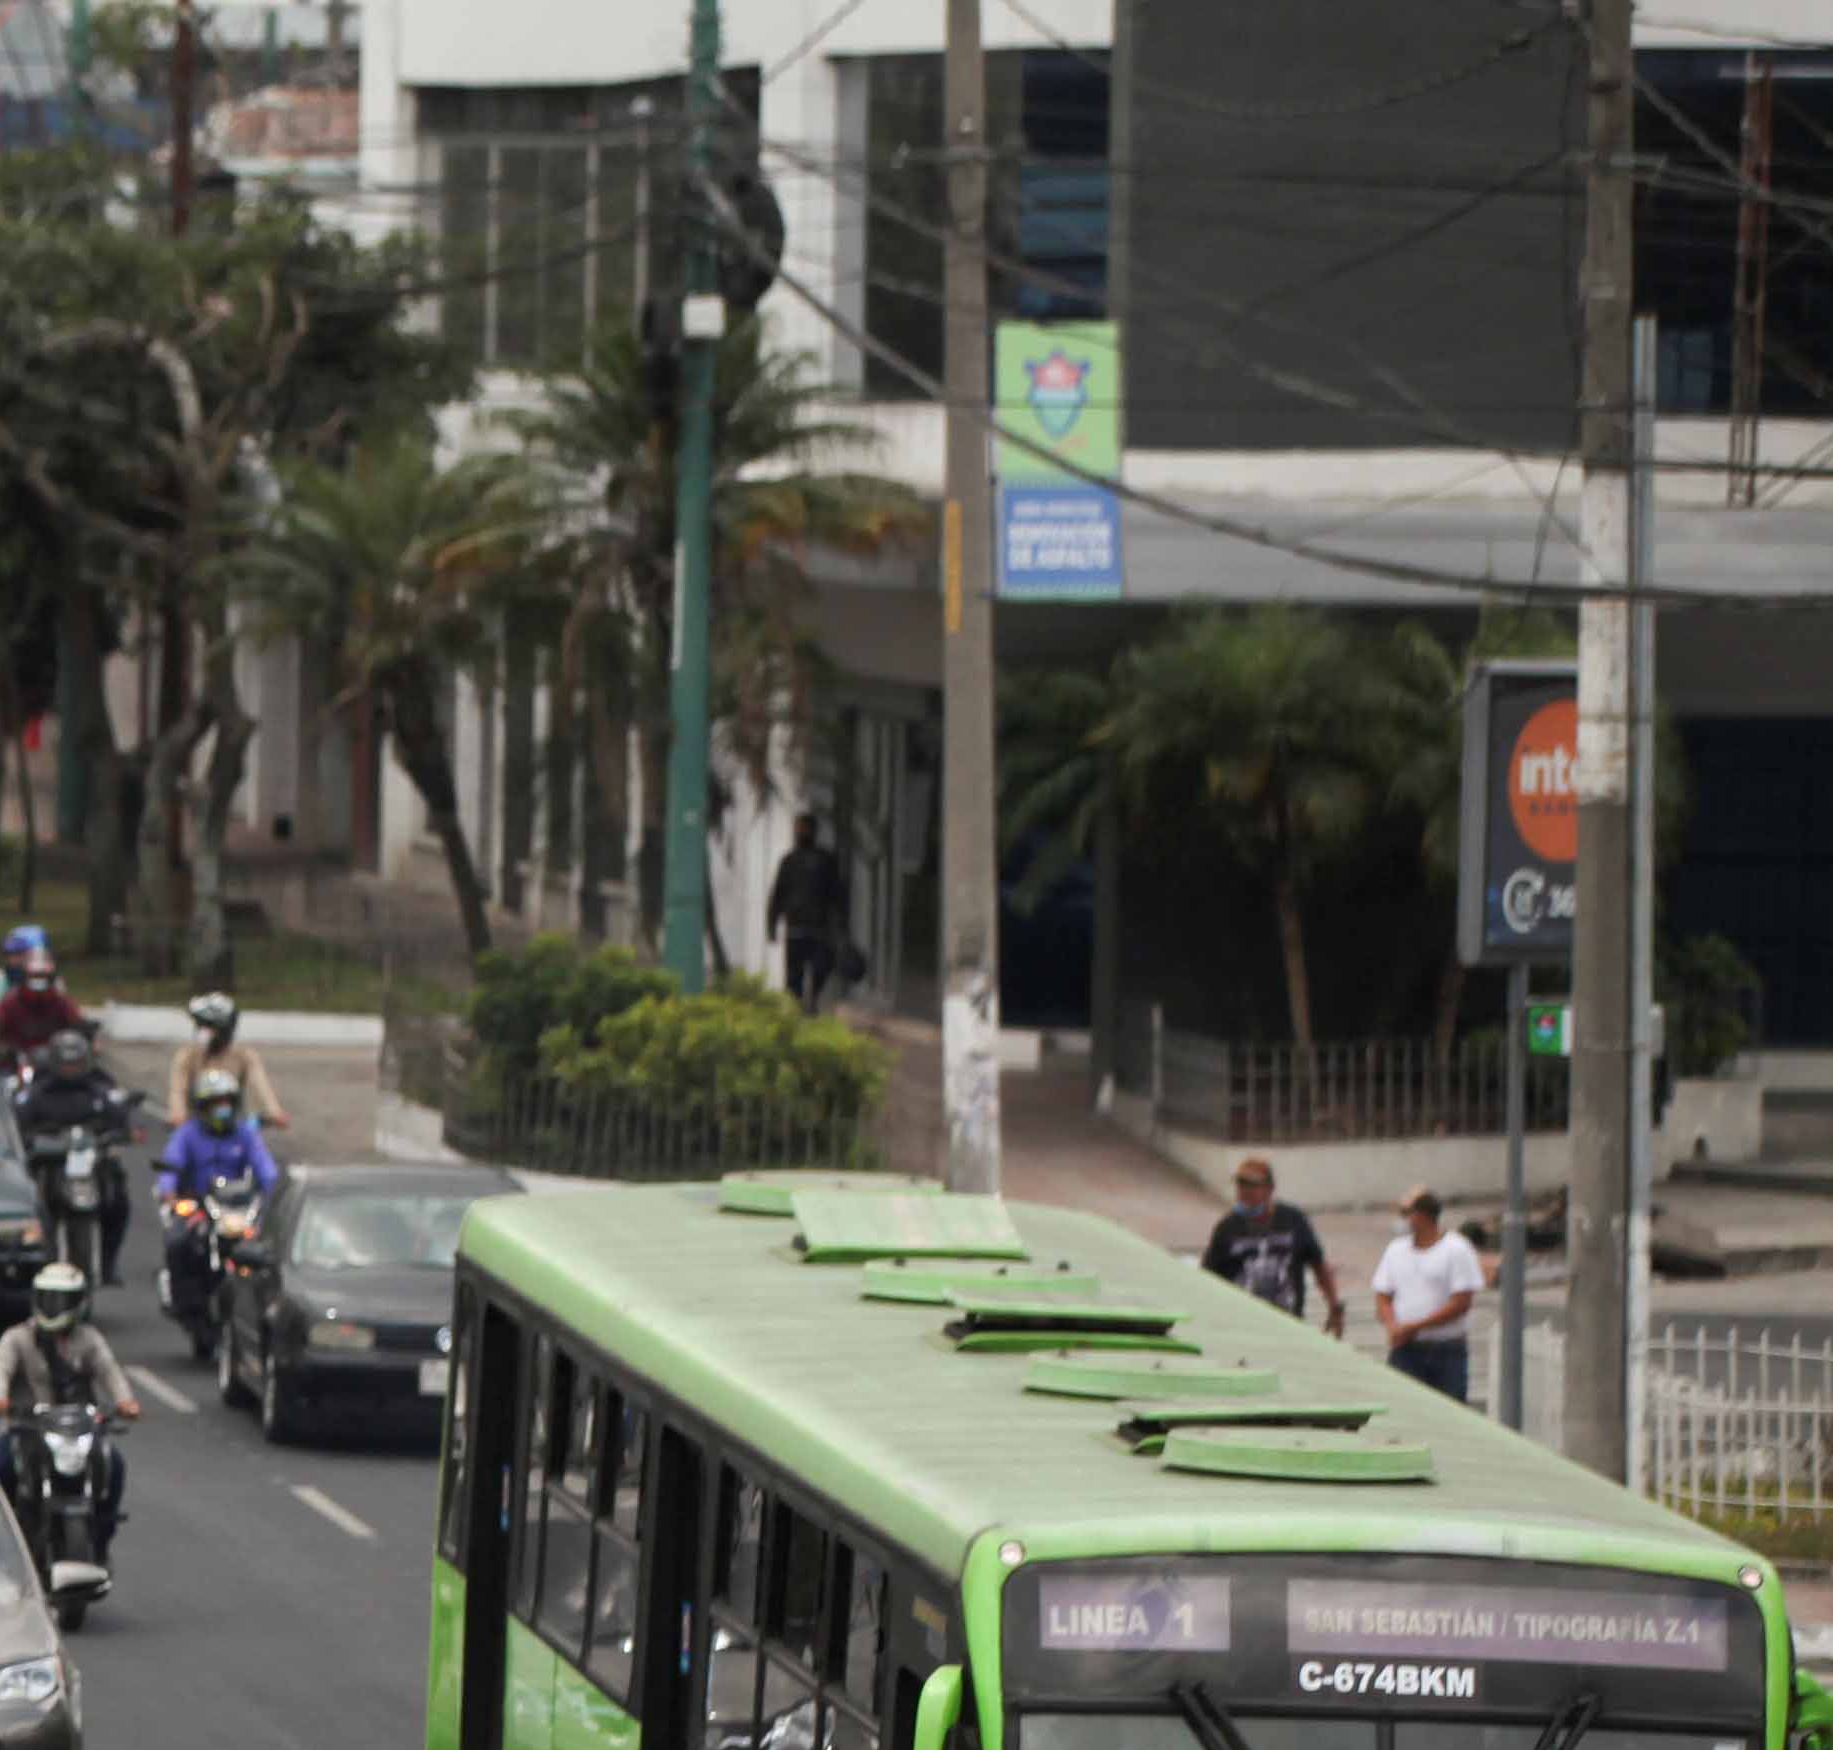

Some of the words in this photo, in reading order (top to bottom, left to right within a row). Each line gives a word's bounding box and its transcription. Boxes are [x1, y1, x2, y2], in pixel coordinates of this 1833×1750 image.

[1049, 1604, 1149, 1638] LINEA
[1174, 1604, 1194, 1638] 1
[1305, 1607, 1354, 1635] SAN
[1298, 1660, 1476, 1698] C-674BKM
